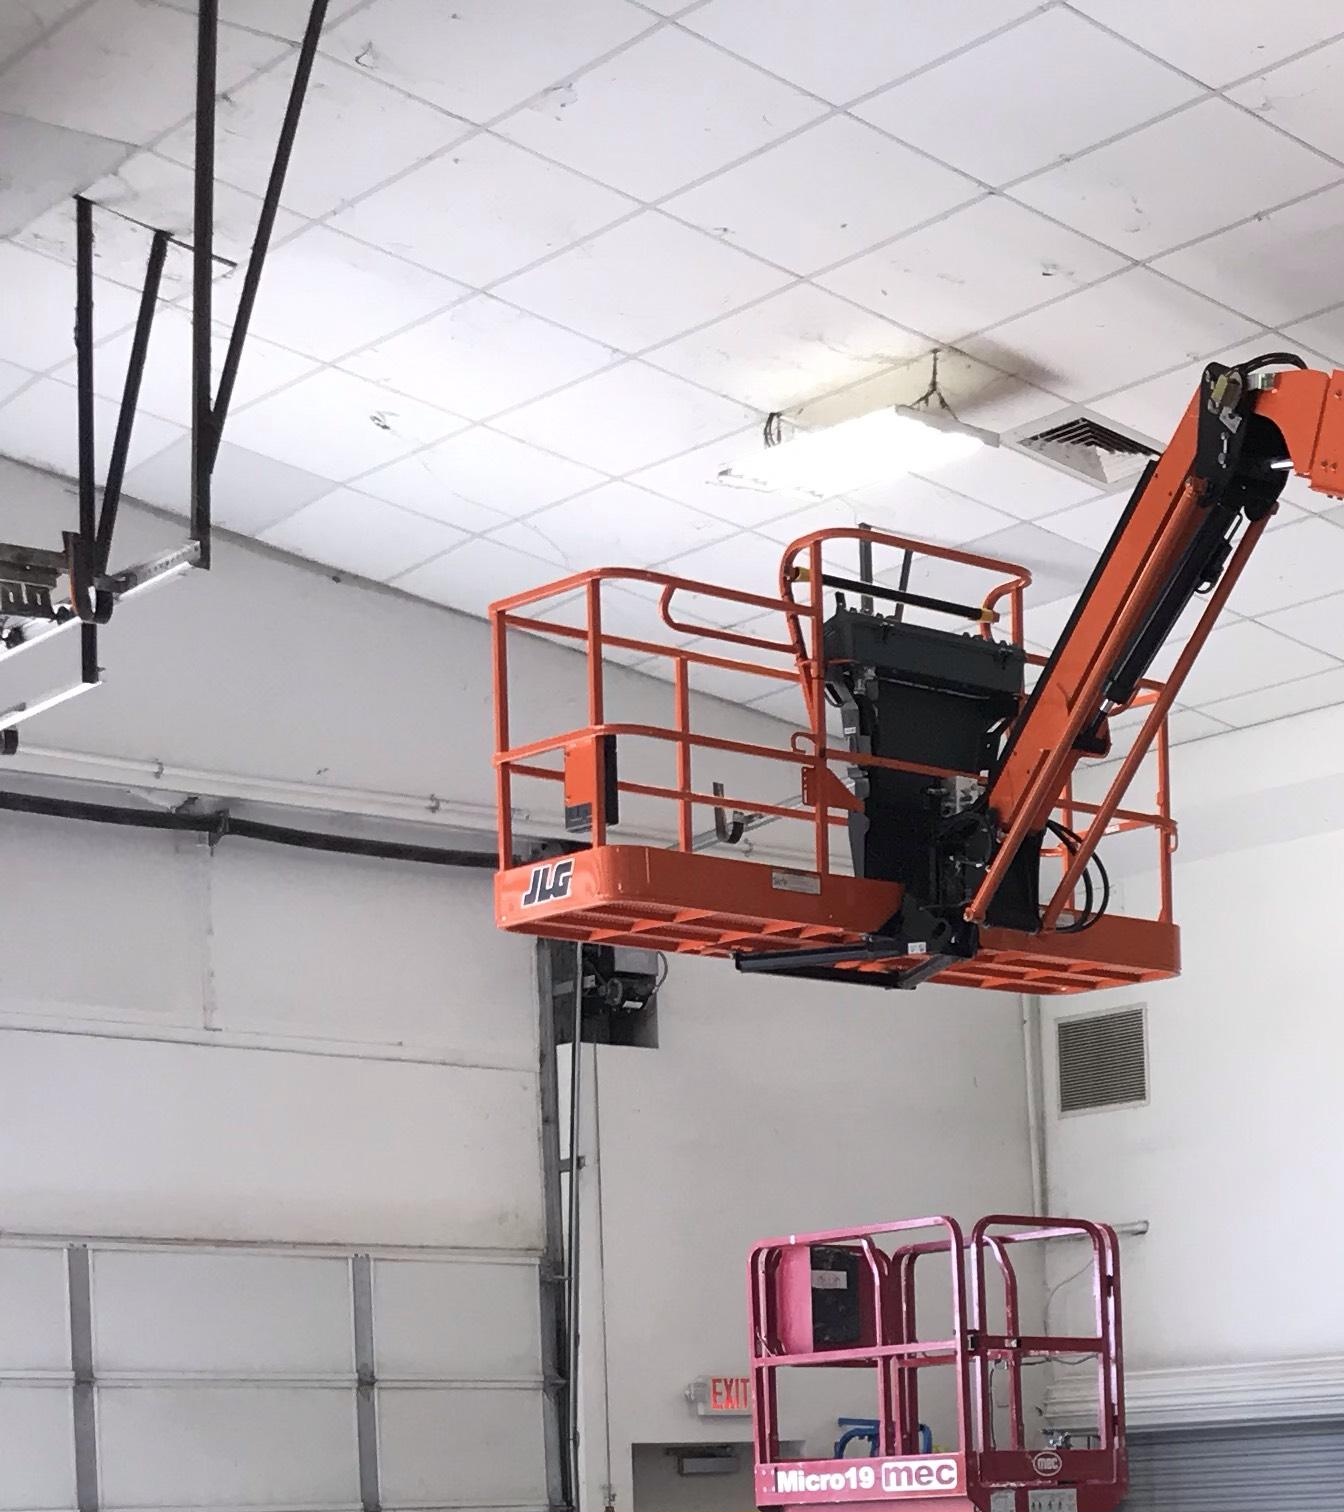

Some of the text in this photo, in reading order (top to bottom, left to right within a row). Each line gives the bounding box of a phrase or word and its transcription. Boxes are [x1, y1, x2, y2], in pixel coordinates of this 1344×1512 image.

[522, 858, 575, 908] JLG
[711, 1378, 750, 1409] EXIT
[777, 1461, 956, 1493] Micro19 mec
[1037, 1457, 1059, 1470] mec
